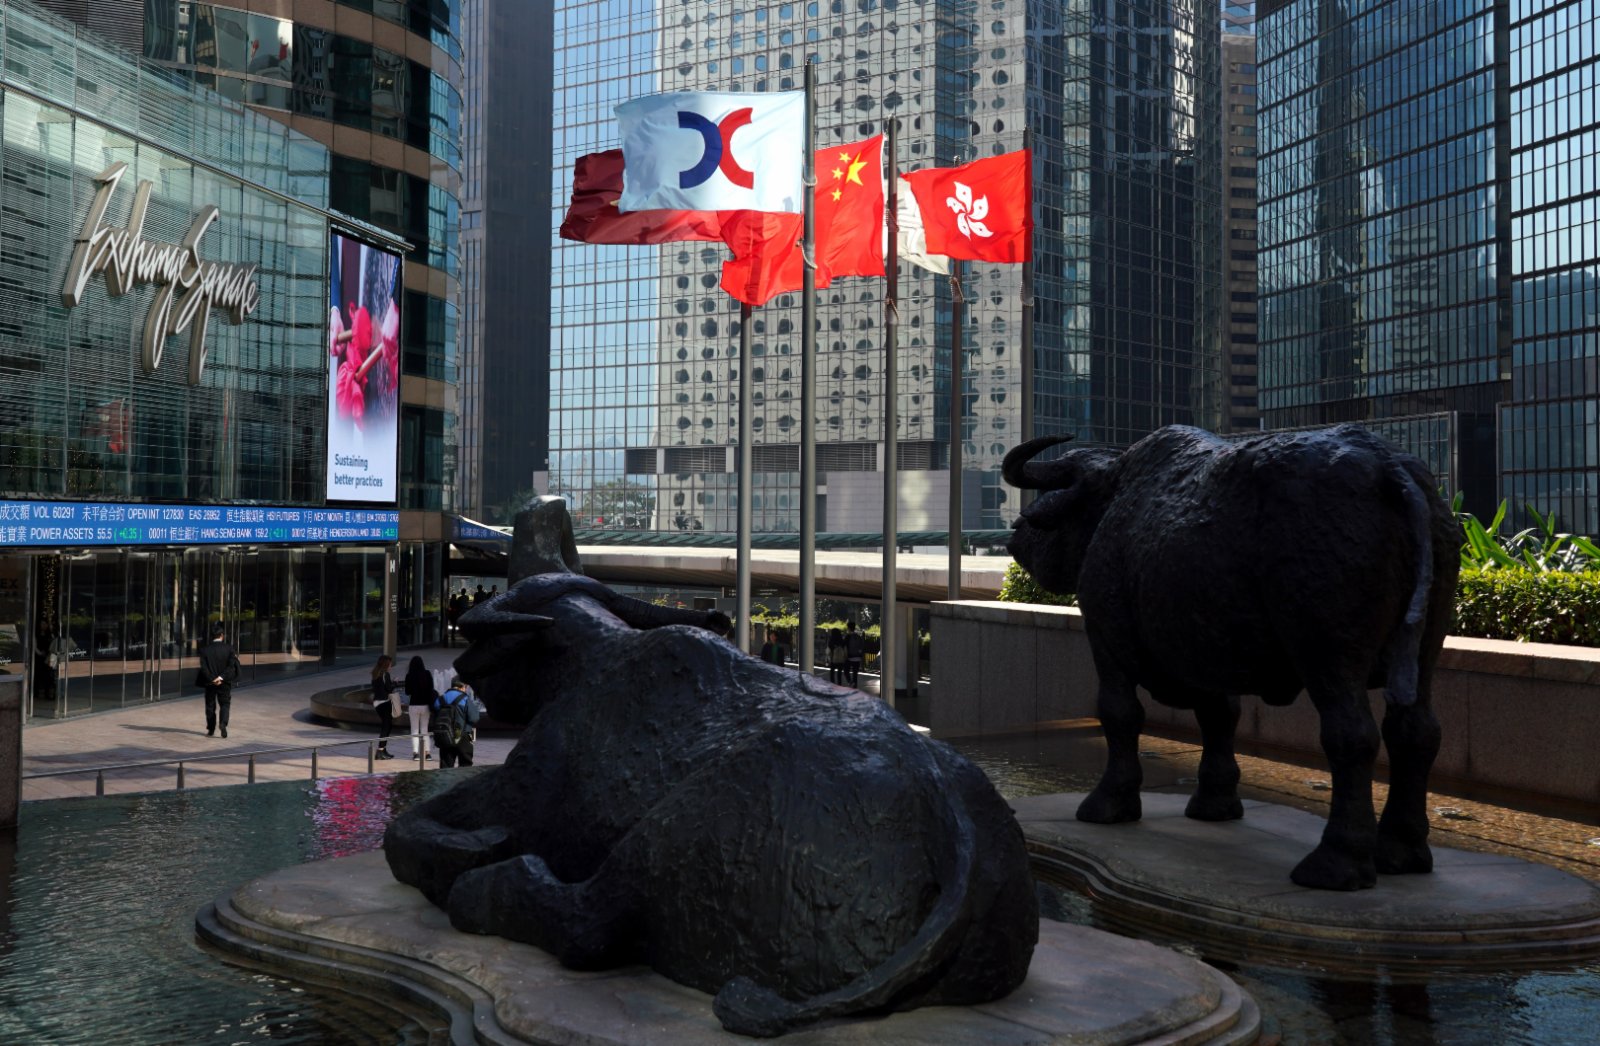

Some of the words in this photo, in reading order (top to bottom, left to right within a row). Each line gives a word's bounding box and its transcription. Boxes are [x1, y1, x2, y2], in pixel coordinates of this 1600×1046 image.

[62, 160, 190, 373] Exchange
[166, 204, 260, 386] Square
[334, 454, 369, 471] Sustaining
[334, 473, 354, 485] better
[355, 475, 383, 489] practices
[33, 506, 50, 519] VOL
[53, 506, 75, 519] 60291
[128, 508, 147, 520] OPEN
[149, 508, 160, 520] INT
[314, 511, 327, 521] NEXT
[327, 511, 343, 522] MONTH
[30, 527, 62, 540] POWER
[63, 527, 94, 540] ASSETS
[97, 527, 112, 540] 55.5
[200, 527, 219, 539] HANG
[219, 527, 236, 539] SENG
[236, 527, 253, 539] BANK
